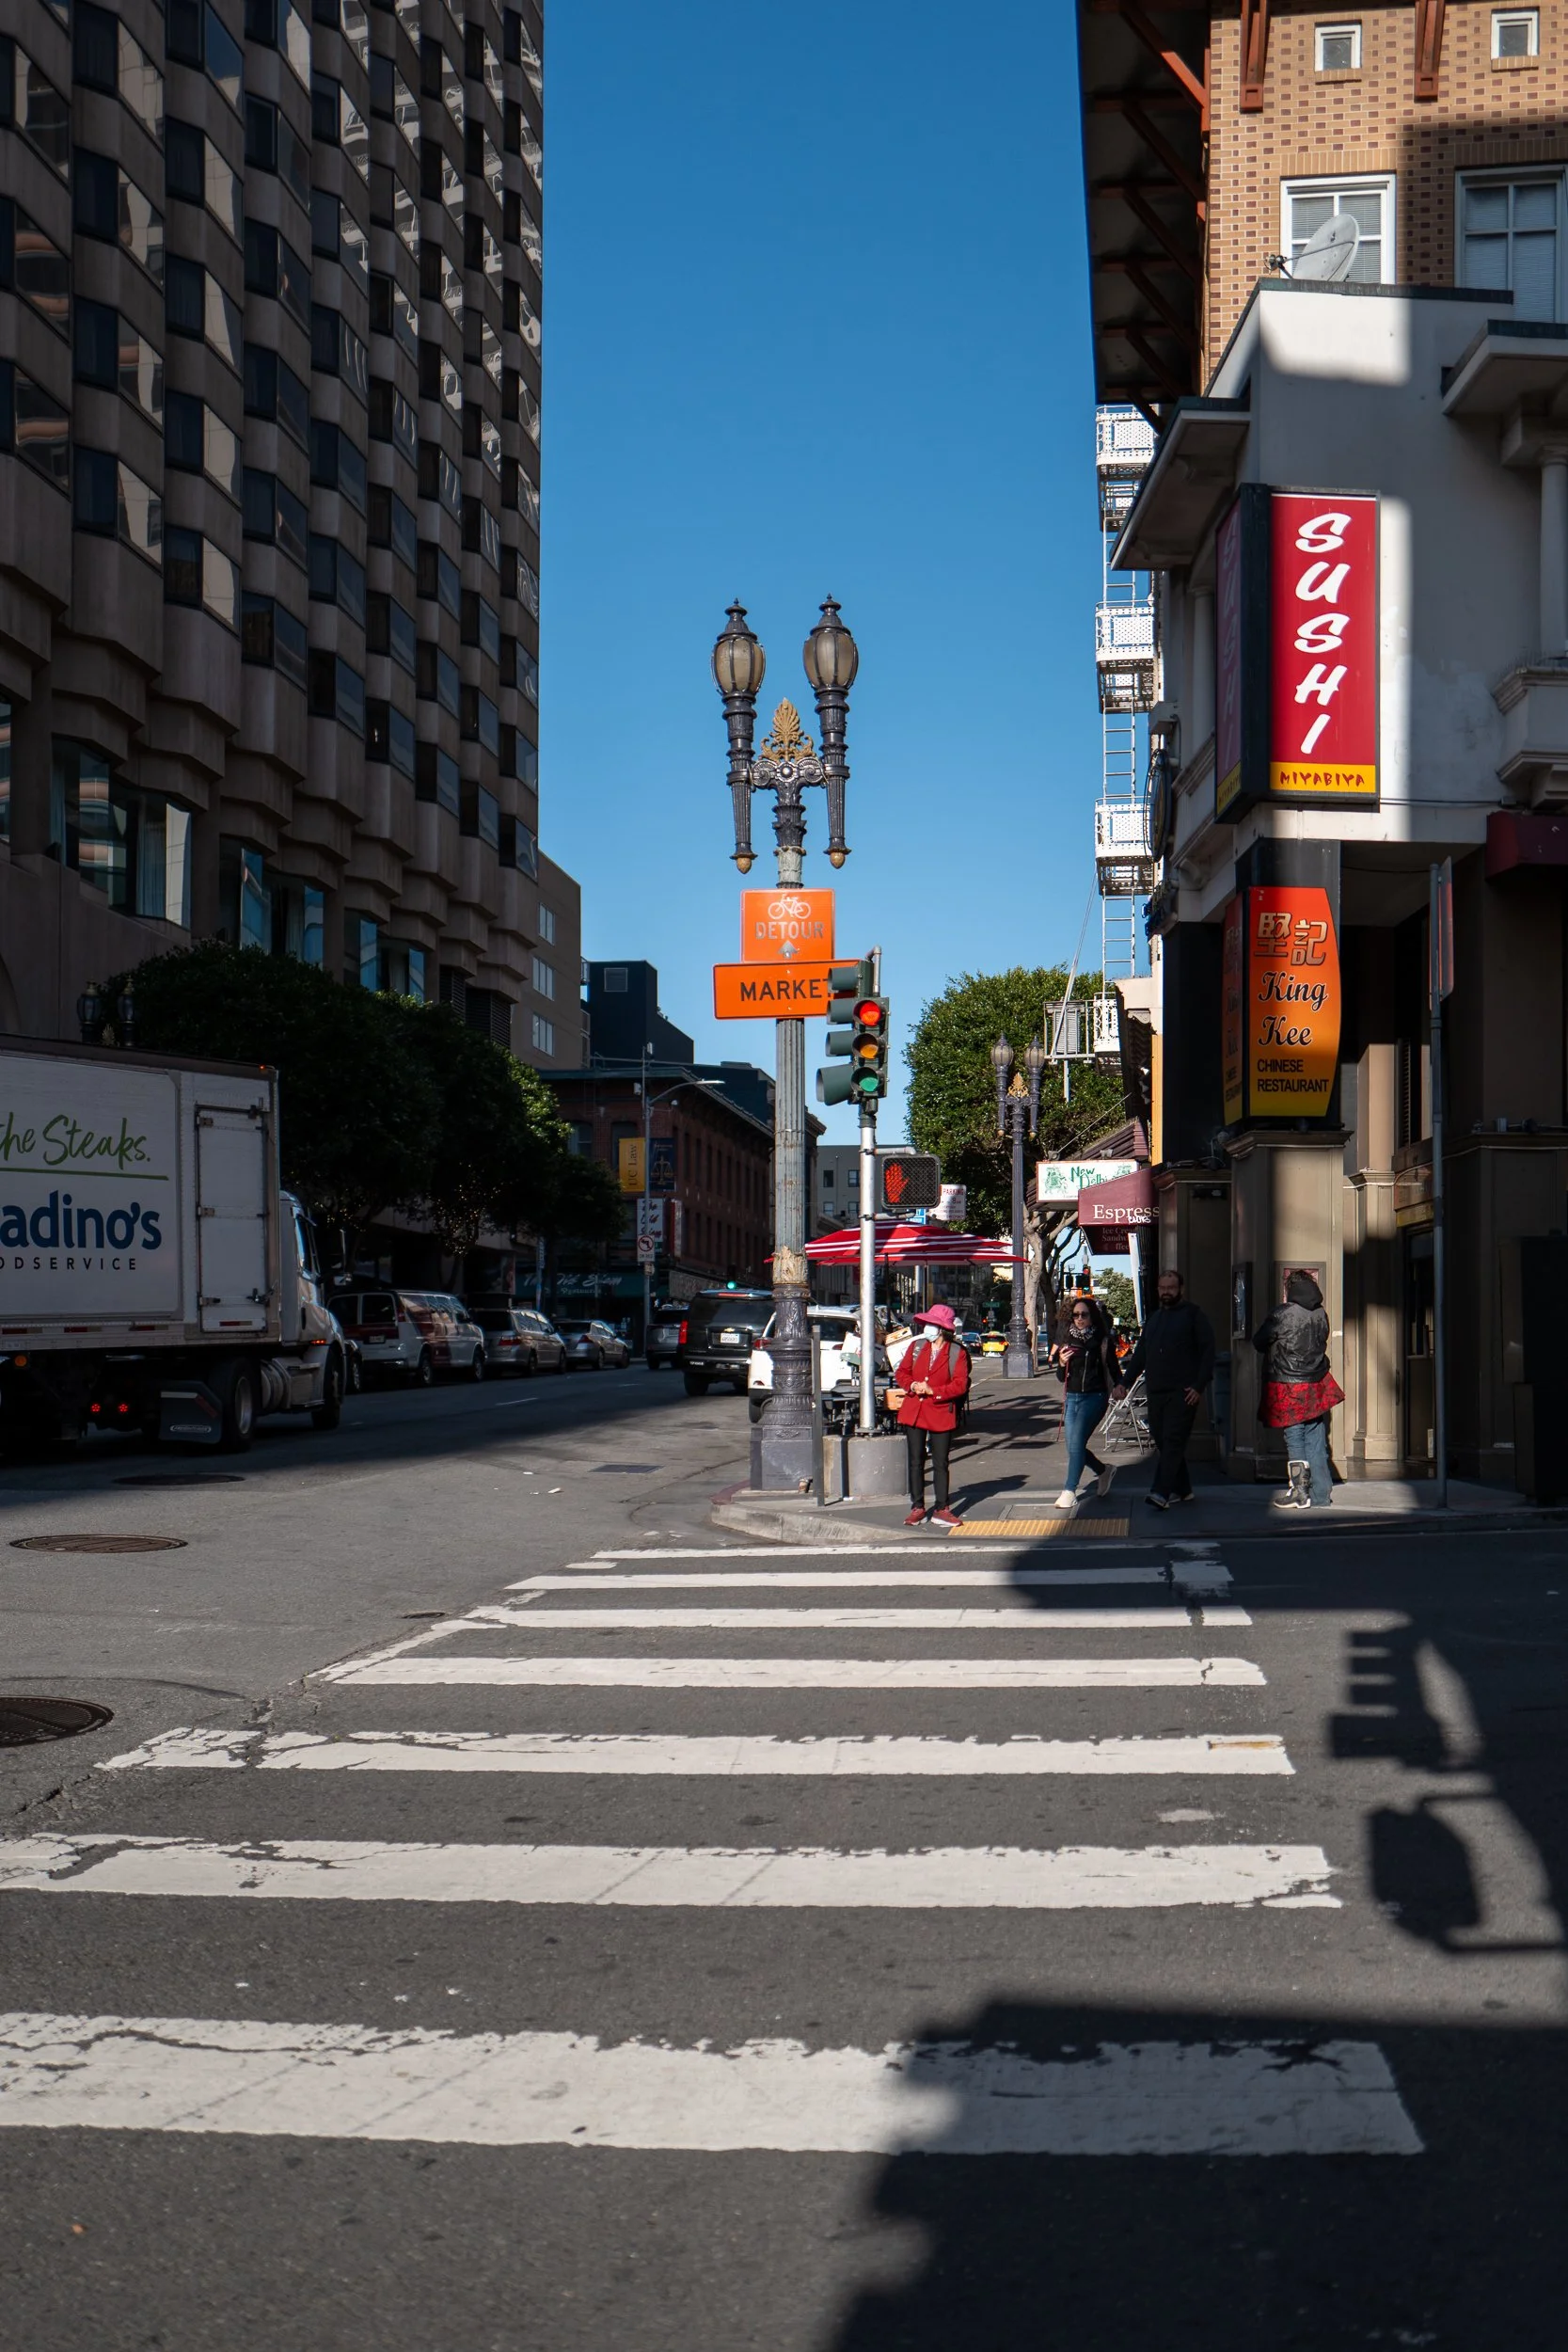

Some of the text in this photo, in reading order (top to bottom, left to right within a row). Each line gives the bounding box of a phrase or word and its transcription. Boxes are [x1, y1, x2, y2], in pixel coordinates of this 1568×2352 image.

[1294, 512, 1353, 755] SUSHI
[1279, 771, 1365, 787] MIYABIYA
[755, 920, 824, 939] DETOUR
[1254, 912, 1328, 965] 堅記
[1257, 971, 1328, 1011] King
[1257, 1016, 1312, 1046] Kee
[1257, 1058, 1304, 1073] CHINESE
[1257, 1078, 1329, 1092] RESTAURANT
[42, 1114, 150, 1169] Steaks.
[1069, 1167, 1096, 1183] New
[1079, 1173, 1108, 1190] Delhi
[0, 1189, 162, 1249] adino's
[1092, 1204, 1160, 1224] Espress
